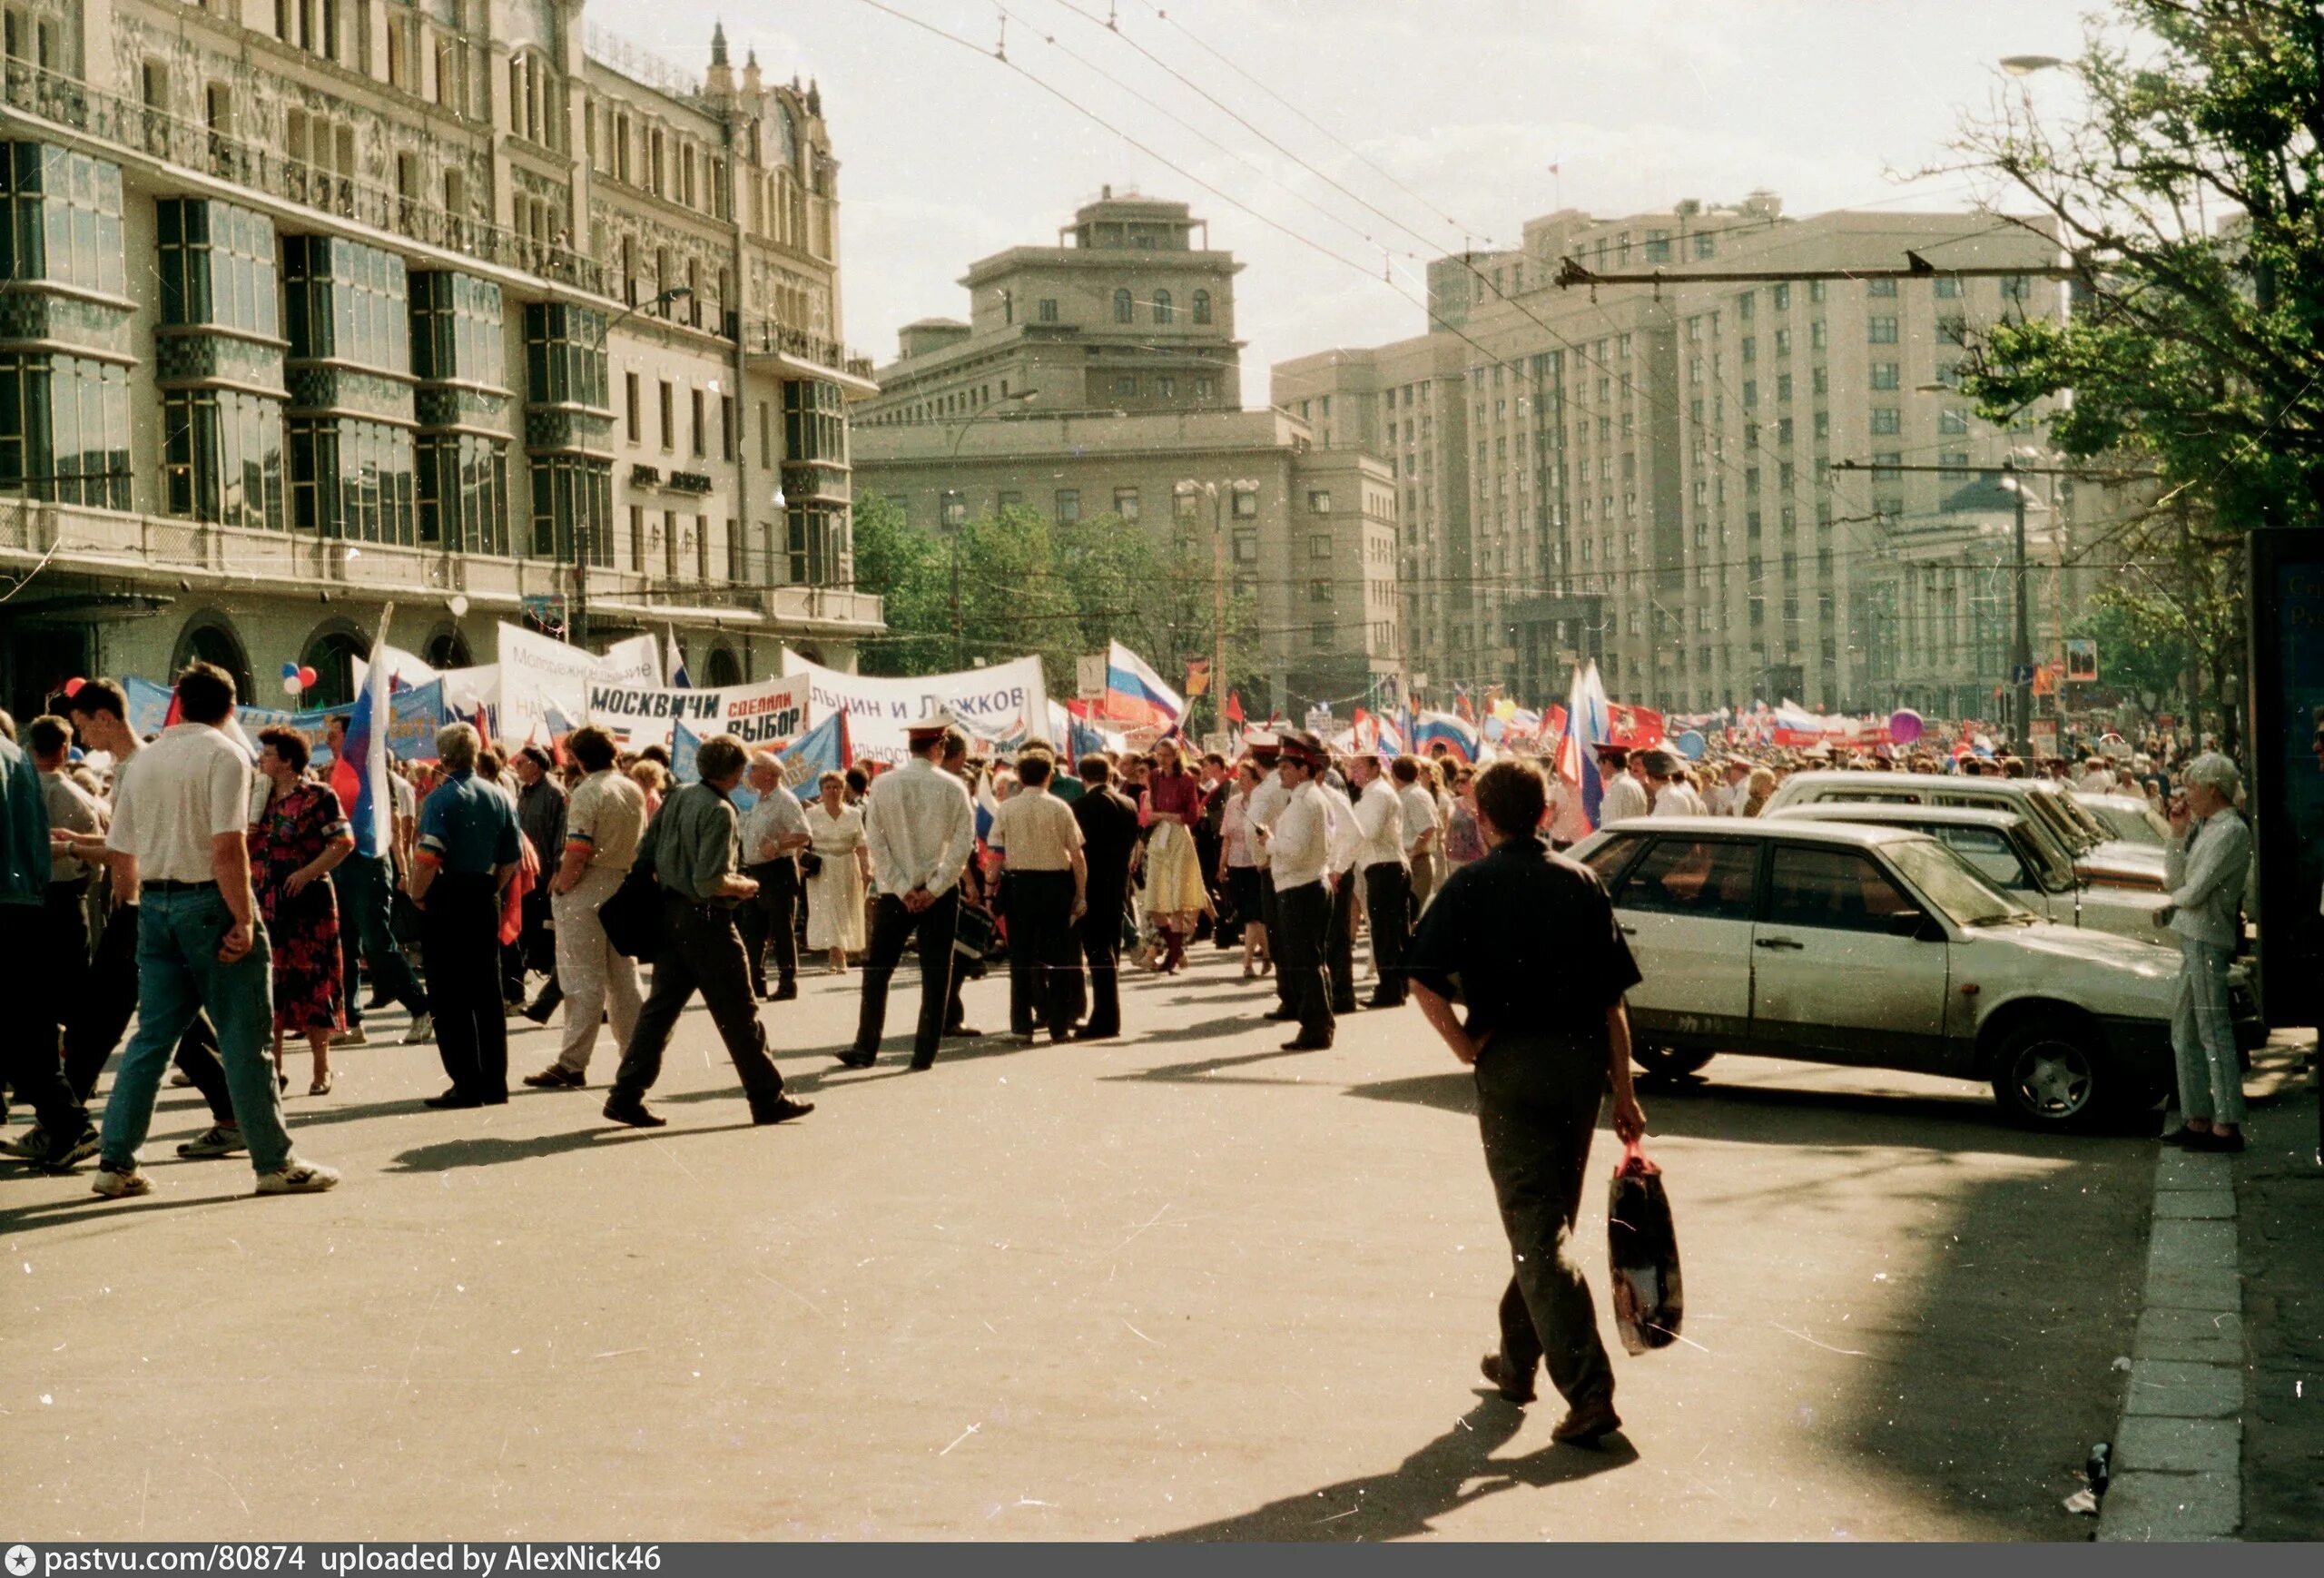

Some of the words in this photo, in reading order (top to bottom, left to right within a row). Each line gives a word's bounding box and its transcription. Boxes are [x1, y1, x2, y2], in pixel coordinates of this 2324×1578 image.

[590, 686, 721, 720] МОСКВИЧИ
[727, 691, 793, 718] СДЕЛАЛИ
[919, 686, 1024, 719] Лжков
